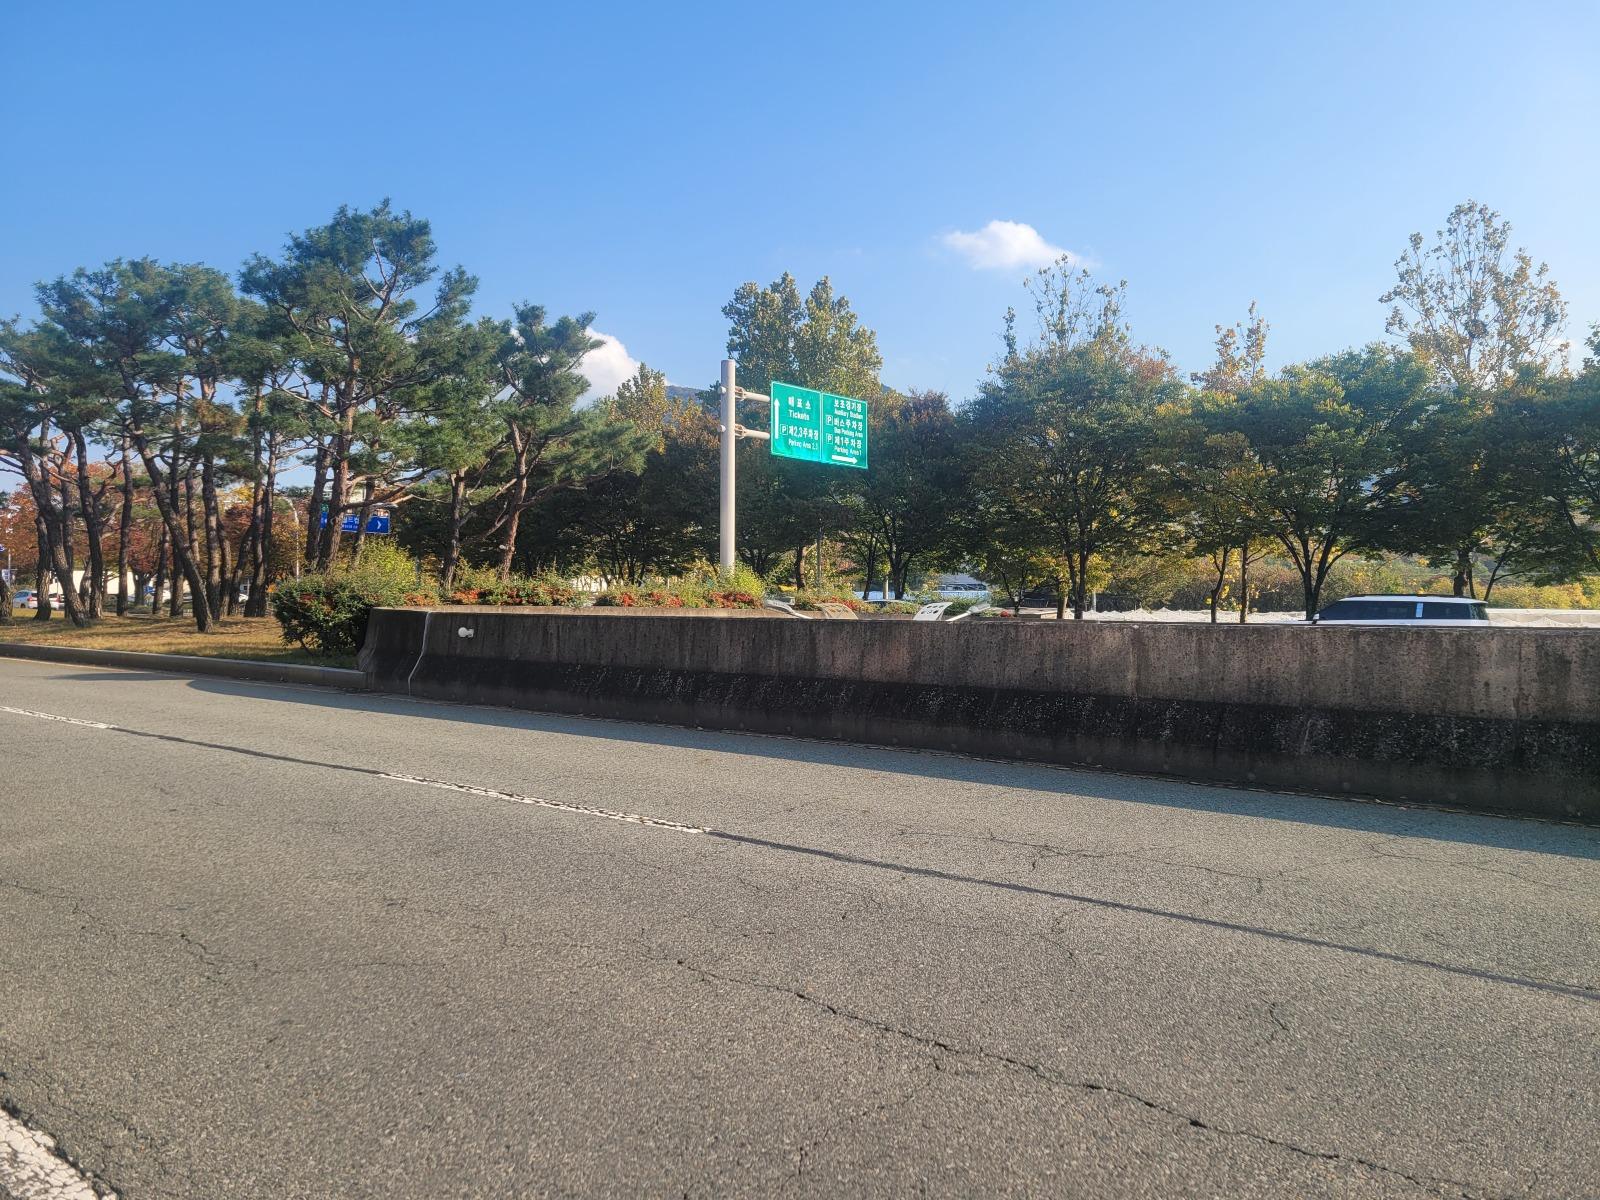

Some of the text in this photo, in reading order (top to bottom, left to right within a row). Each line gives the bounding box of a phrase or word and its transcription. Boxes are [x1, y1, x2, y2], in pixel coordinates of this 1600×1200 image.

[788, 410, 810, 420] Tickets
[833, 417, 863, 431] 버스주차장
[788, 439, 802, 448] Parking
[834, 435, 862, 449] 제1주차장
[834, 446, 848, 456] Parking
